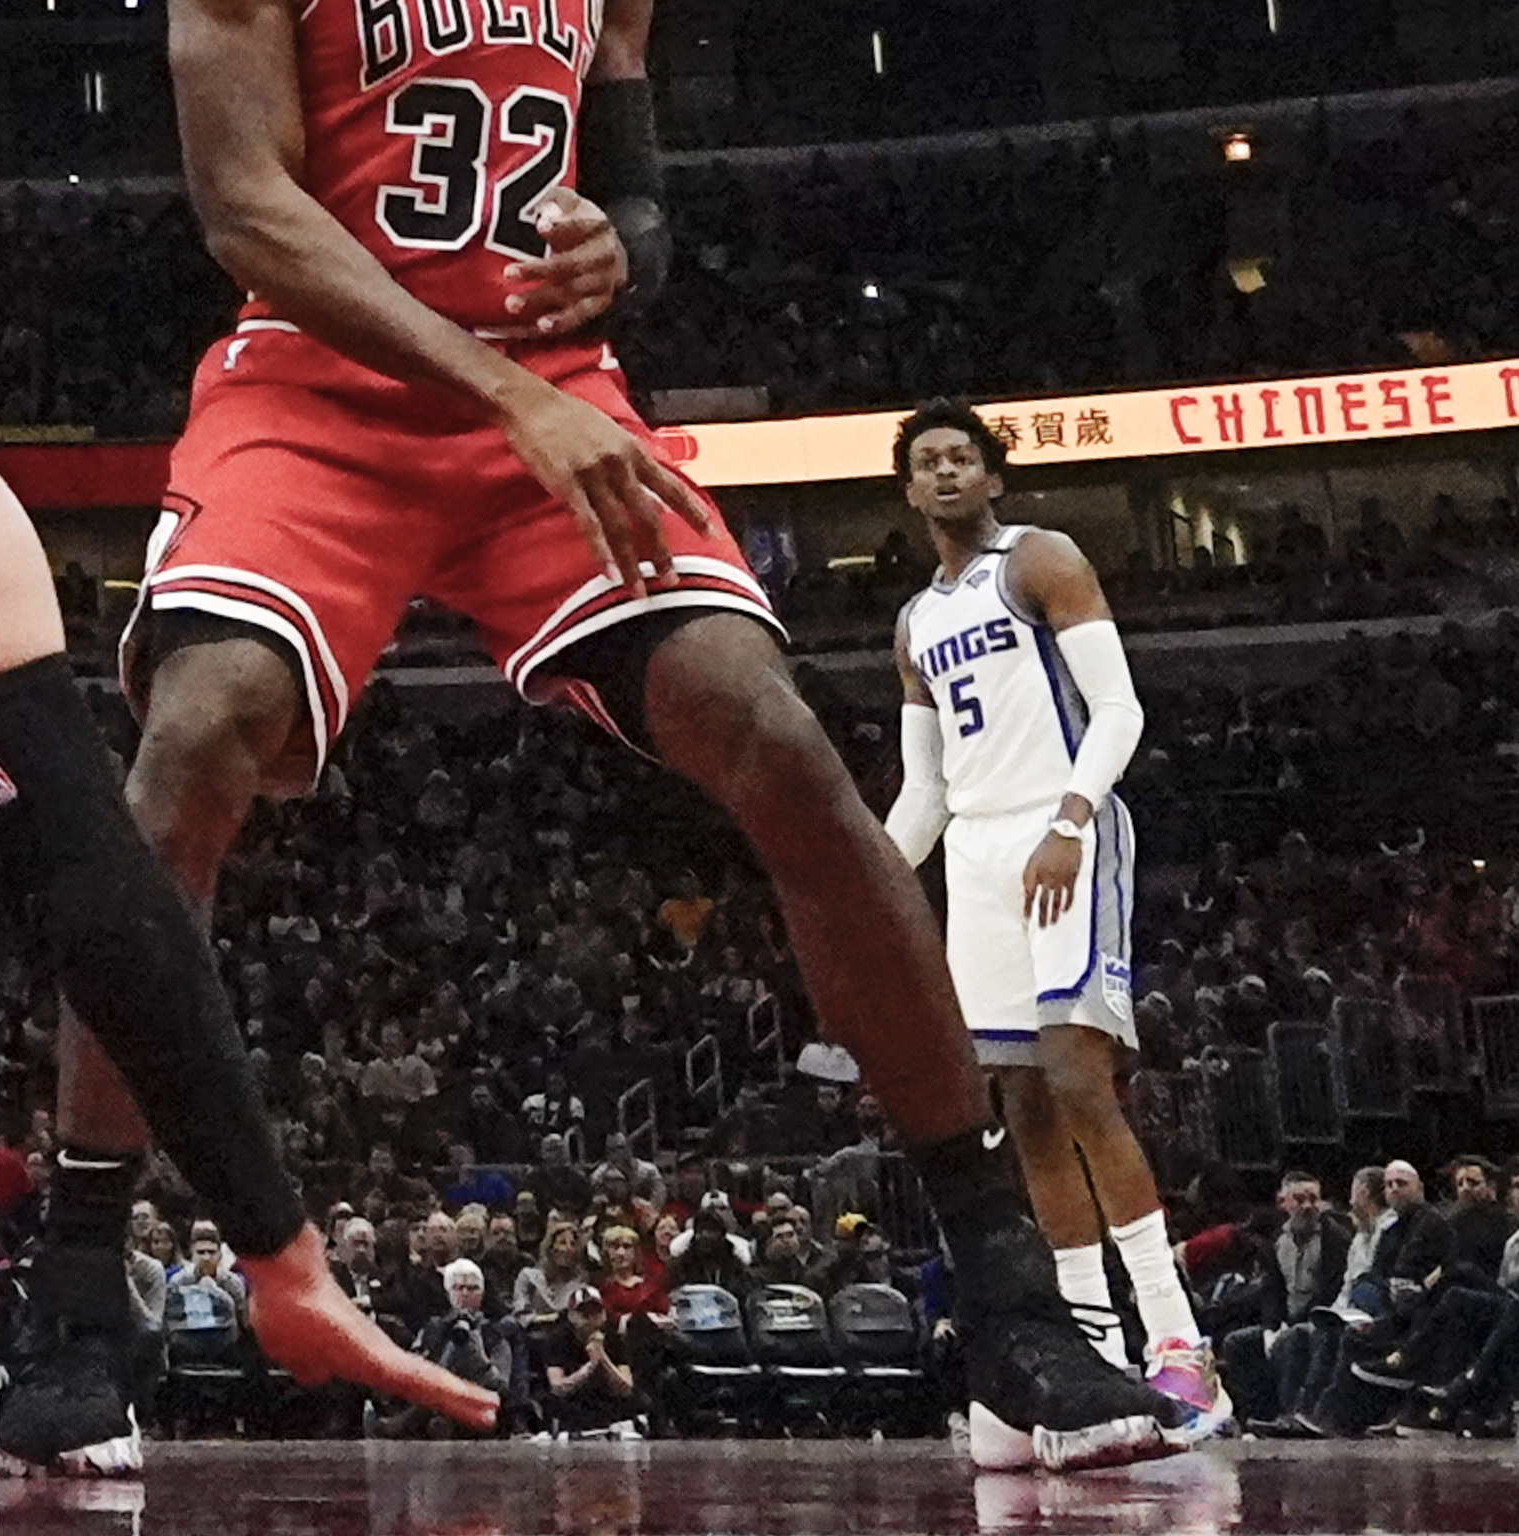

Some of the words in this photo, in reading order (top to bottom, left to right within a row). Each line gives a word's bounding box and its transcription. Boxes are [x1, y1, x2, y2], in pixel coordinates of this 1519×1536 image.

[374, 76, 574, 263] 32
[1169, 376, 1455, 444] CHINESE
[949, 672, 985, 739] 5
